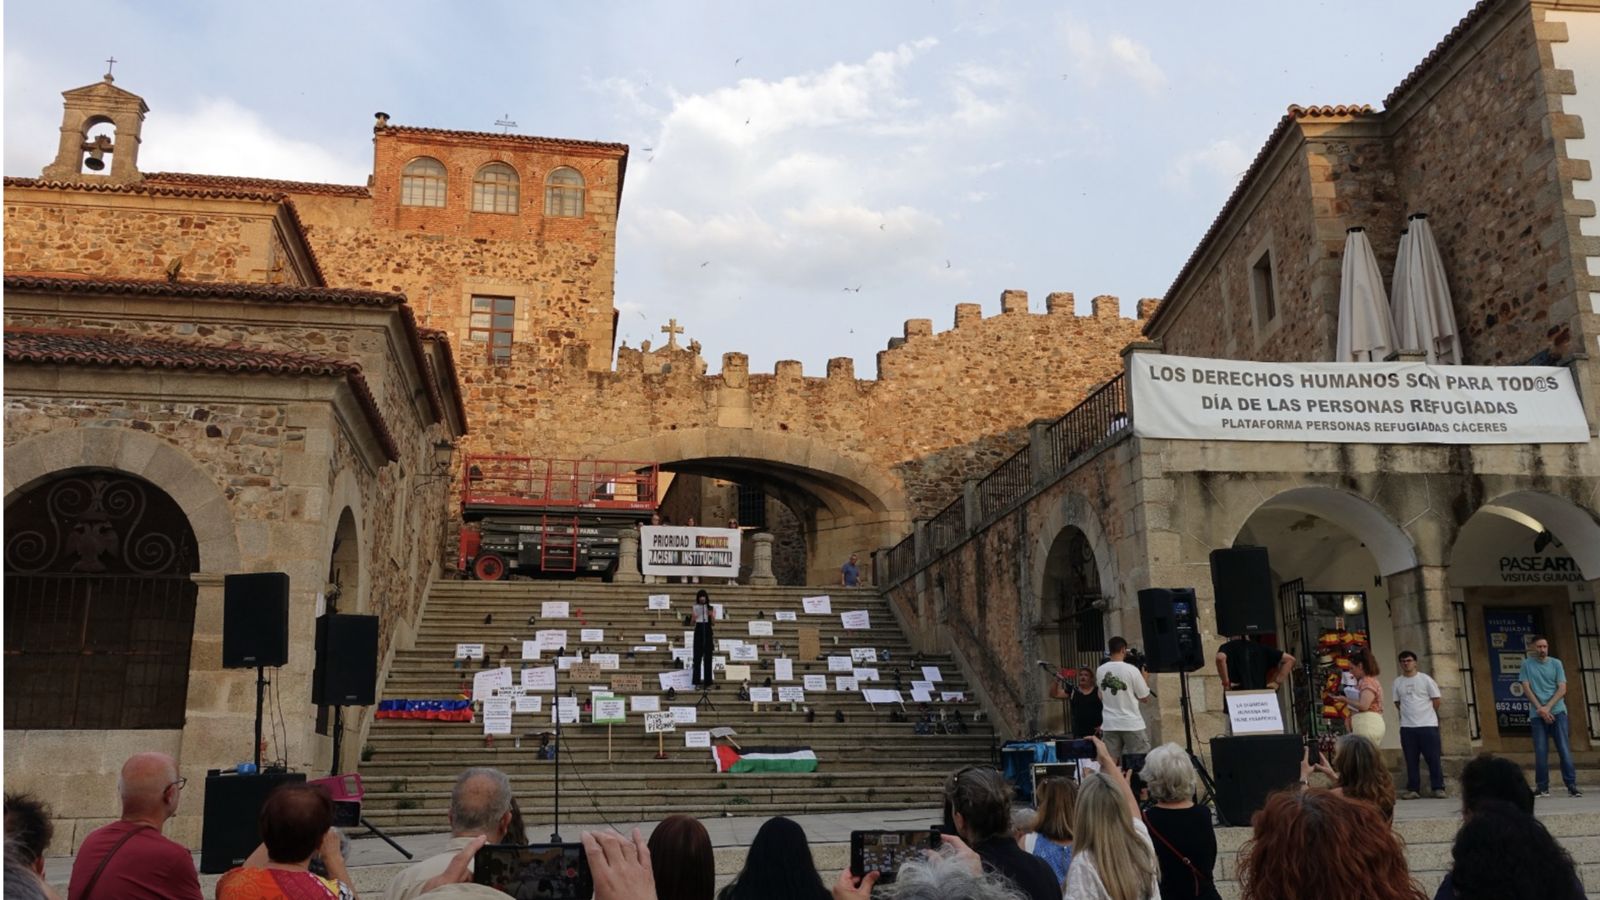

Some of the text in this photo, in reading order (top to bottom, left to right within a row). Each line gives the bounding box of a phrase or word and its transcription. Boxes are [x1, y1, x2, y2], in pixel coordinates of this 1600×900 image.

[1150, 365, 1559, 392] LOS DERECHOS HUMANOS SON PARA TOD@S
[1202, 394, 1518, 415] DÍA DE LAS PERSONAS REFUGIADAS
[1221, 418, 1508, 433] PLATAFORMA PERSONAS REFUGIADAS CÁCERES
[653, 534, 690, 548] PRIORIDAD
[1499, 556, 1581, 572] PASEART
[1501, 572, 1540, 583] VISITAS
[1511, 702, 1522, 711] 40
